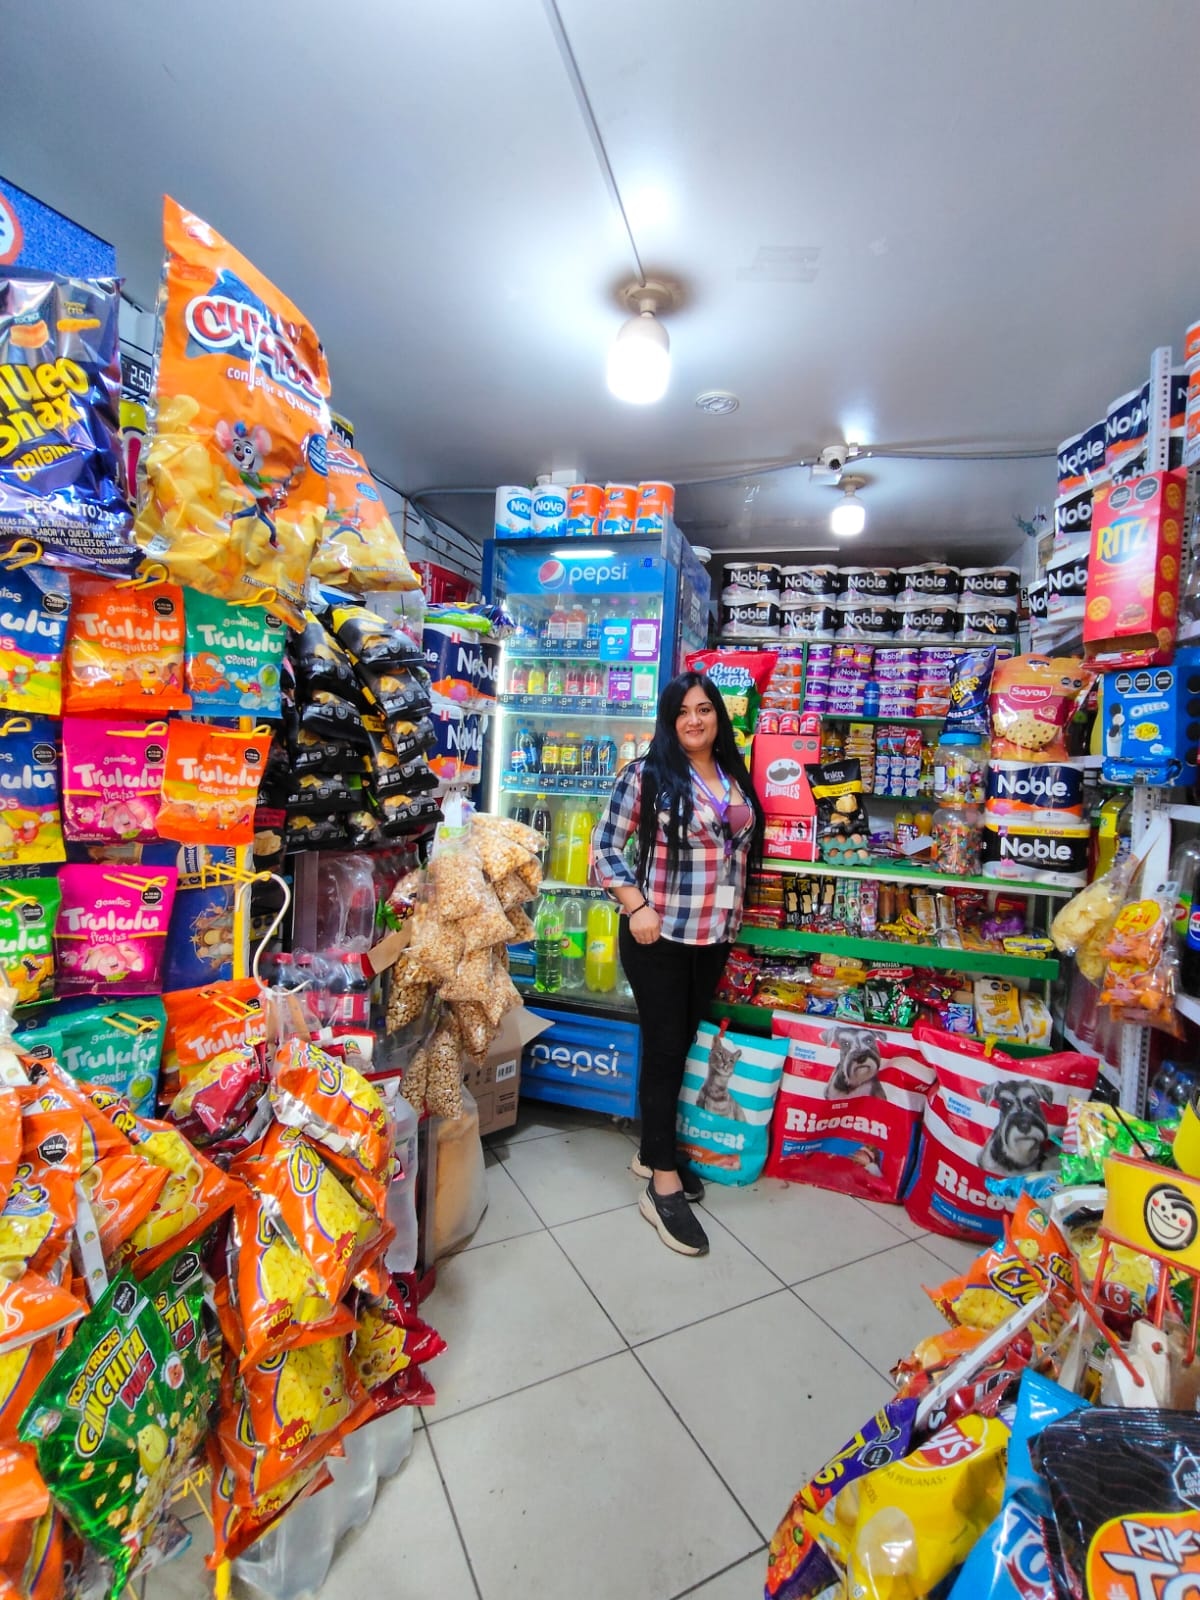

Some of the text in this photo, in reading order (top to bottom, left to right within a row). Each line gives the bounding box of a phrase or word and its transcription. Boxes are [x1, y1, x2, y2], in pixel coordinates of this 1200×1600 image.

[227, 367, 249, 384] con
[285, 392, 321, 419] Ques
[1057, 438, 1105, 477] Noble
[535, 500, 564, 514] Nova
[1056, 502, 1092, 528] Nob
[1096, 518, 1150, 561] RITZ
[569, 562, 628, 585] pepsi
[905, 575, 946, 588] Noble
[964, 577, 1007, 590] Noble
[1048, 568, 1088, 592] Nob
[76, 612, 180, 643] Trululu
[844, 612, 883, 625] Noble
[903, 614, 943, 626] Noble
[197, 624, 282, 654] Trululu
[1011, 686, 1048, 698] Sayon
[73, 763, 163, 789] Trululu
[177, 758, 261, 788] Trululu
[765, 782, 801, 800] PRINGLES
[62, 907, 160, 937] Trululu
[62, 1044, 159, 1074] Trululu
[530, 1043, 620, 1078] pepsi
[785, 1107, 889, 1141] Ricocan
[86, 1329, 121, 1382] TRICKS
[77, 1327, 147, 1457] CINCHITA
